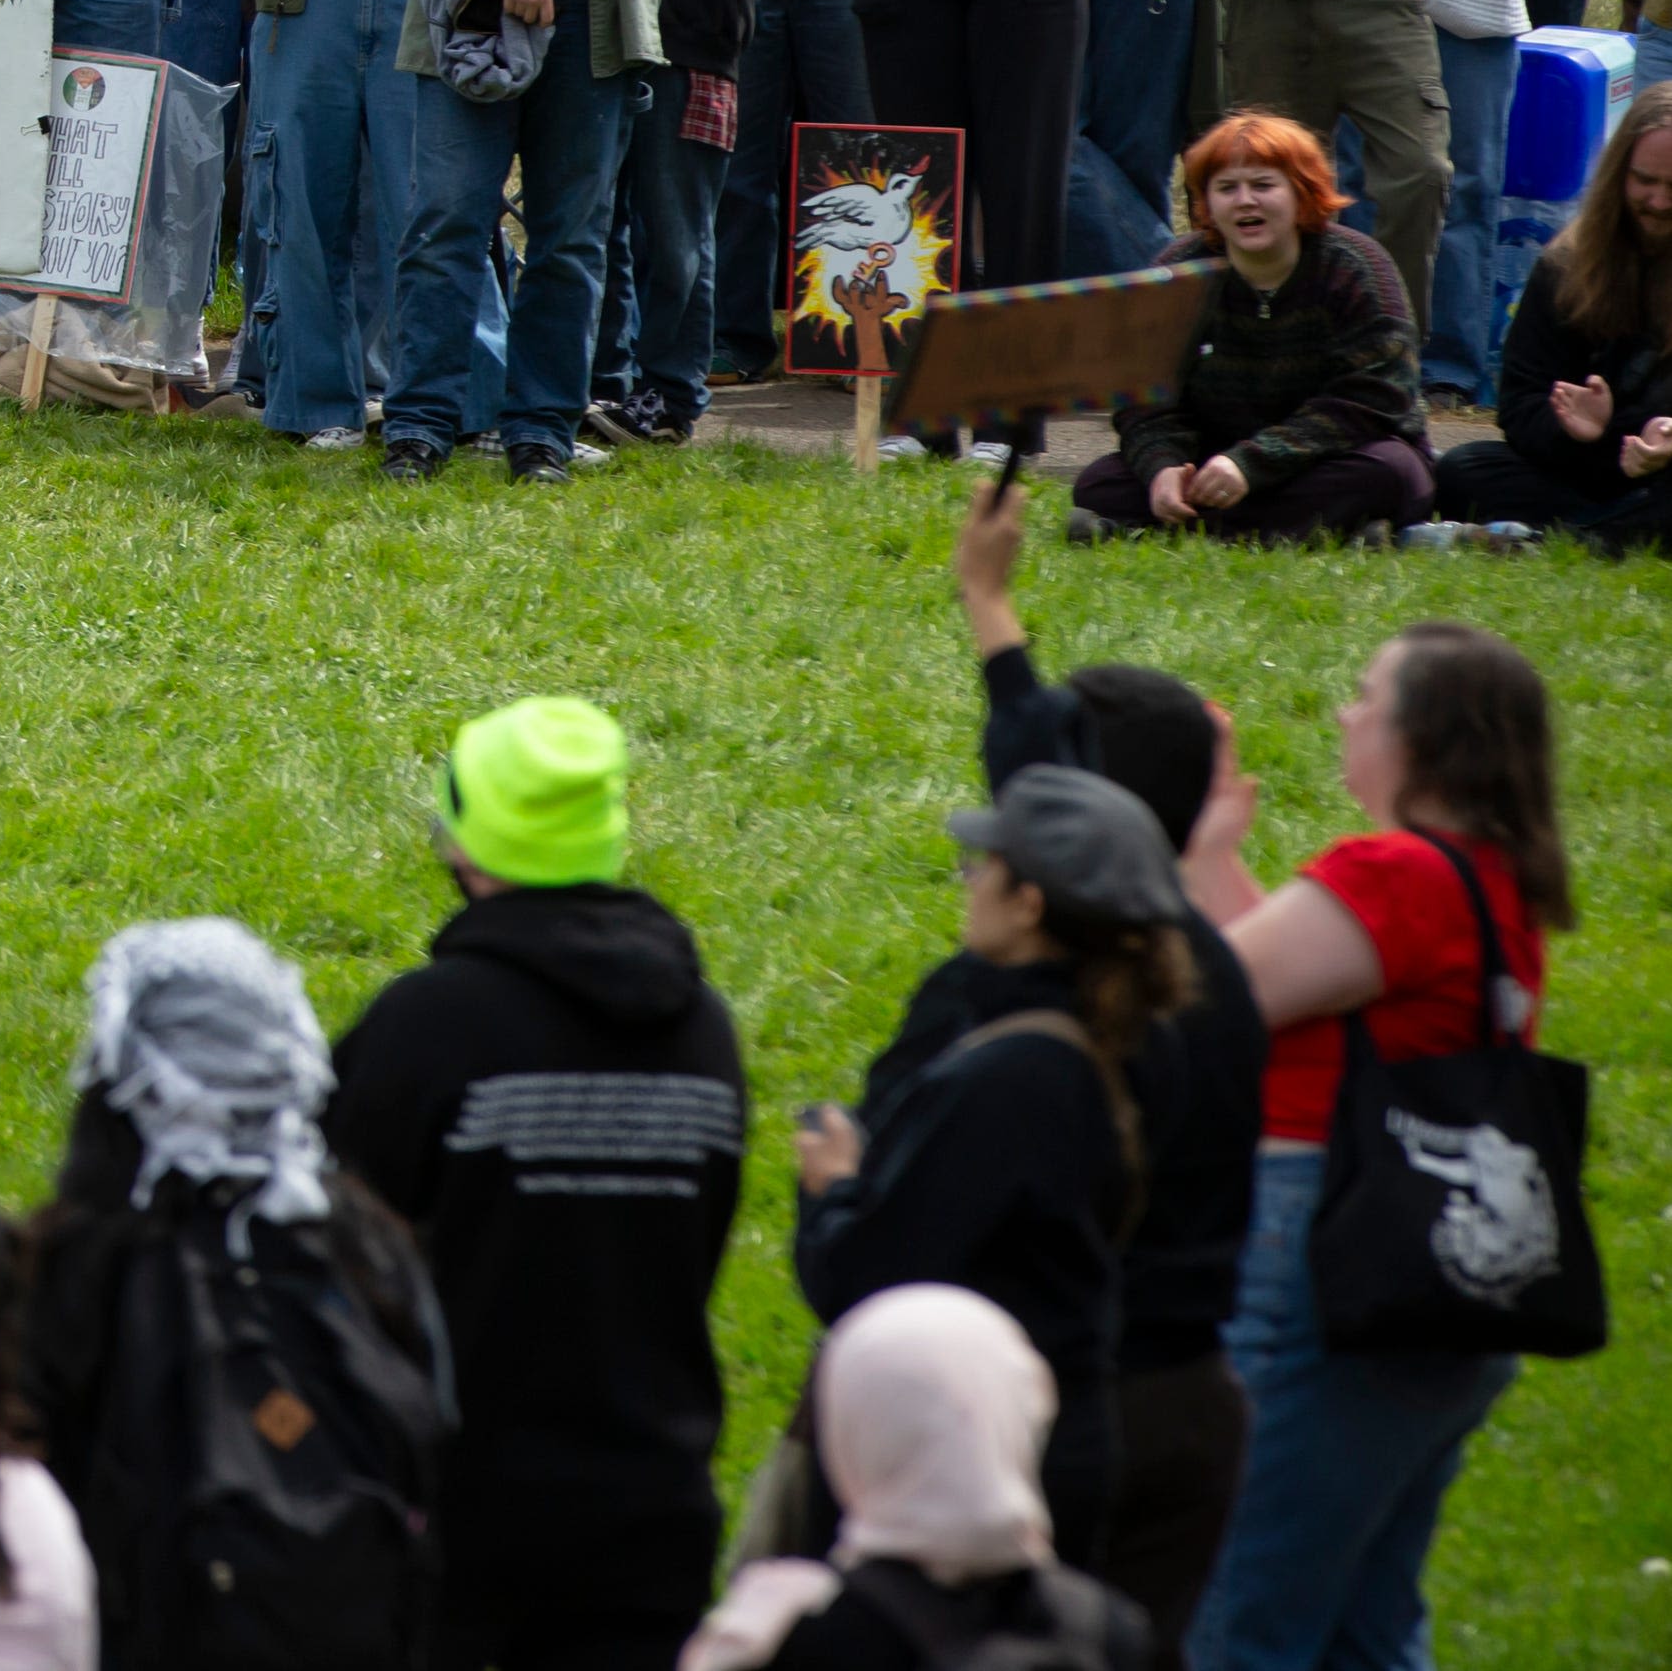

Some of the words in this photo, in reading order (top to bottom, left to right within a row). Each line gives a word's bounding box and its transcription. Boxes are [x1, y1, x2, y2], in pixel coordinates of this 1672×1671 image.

[47, 116, 119, 160] HAT
[45, 154, 85, 189] ILL
[42, 188, 131, 237] STORY
[39, 235, 85, 279] BOUT
